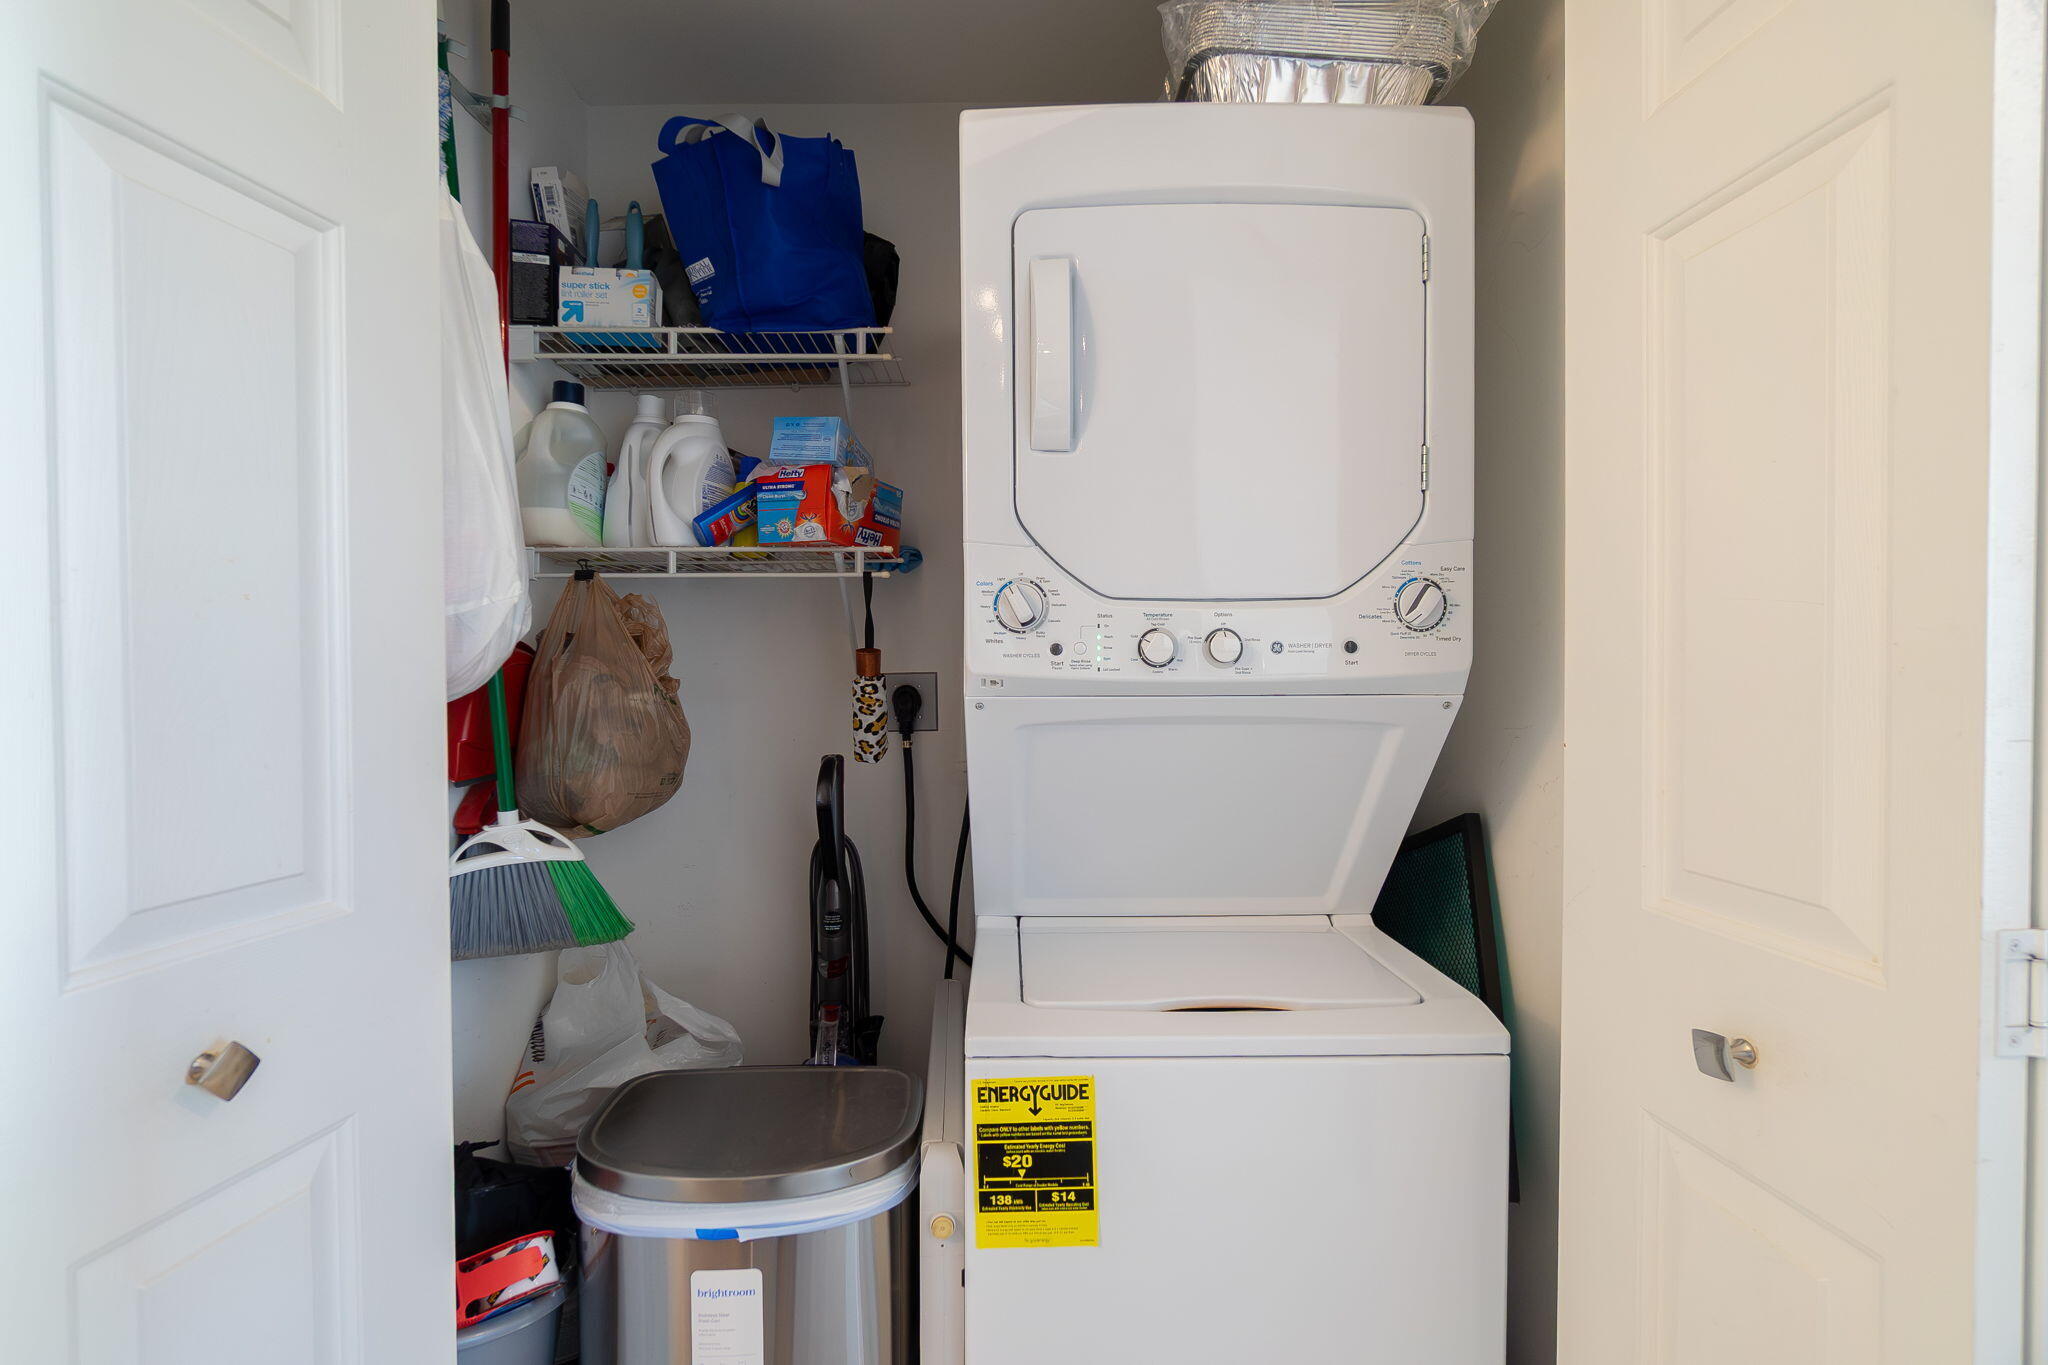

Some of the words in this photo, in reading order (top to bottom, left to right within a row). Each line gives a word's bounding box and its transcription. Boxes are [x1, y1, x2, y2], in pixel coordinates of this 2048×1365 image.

[561, 282, 585, 290] super
[589, 282, 610, 290] stick
[779, 470, 803, 478] Hefty
[858, 527, 881, 546] Hefty
[977, 1083, 1090, 1104] ENERGYGUIDE
[1054, 1124, 1069, 1132] yellow
[1002, 1154, 1032, 1168] $20
[990, 1195, 1012, 1205] 138
[1052, 1191, 1076, 1202] $14
[697, 1288, 756, 1299] brightroom
